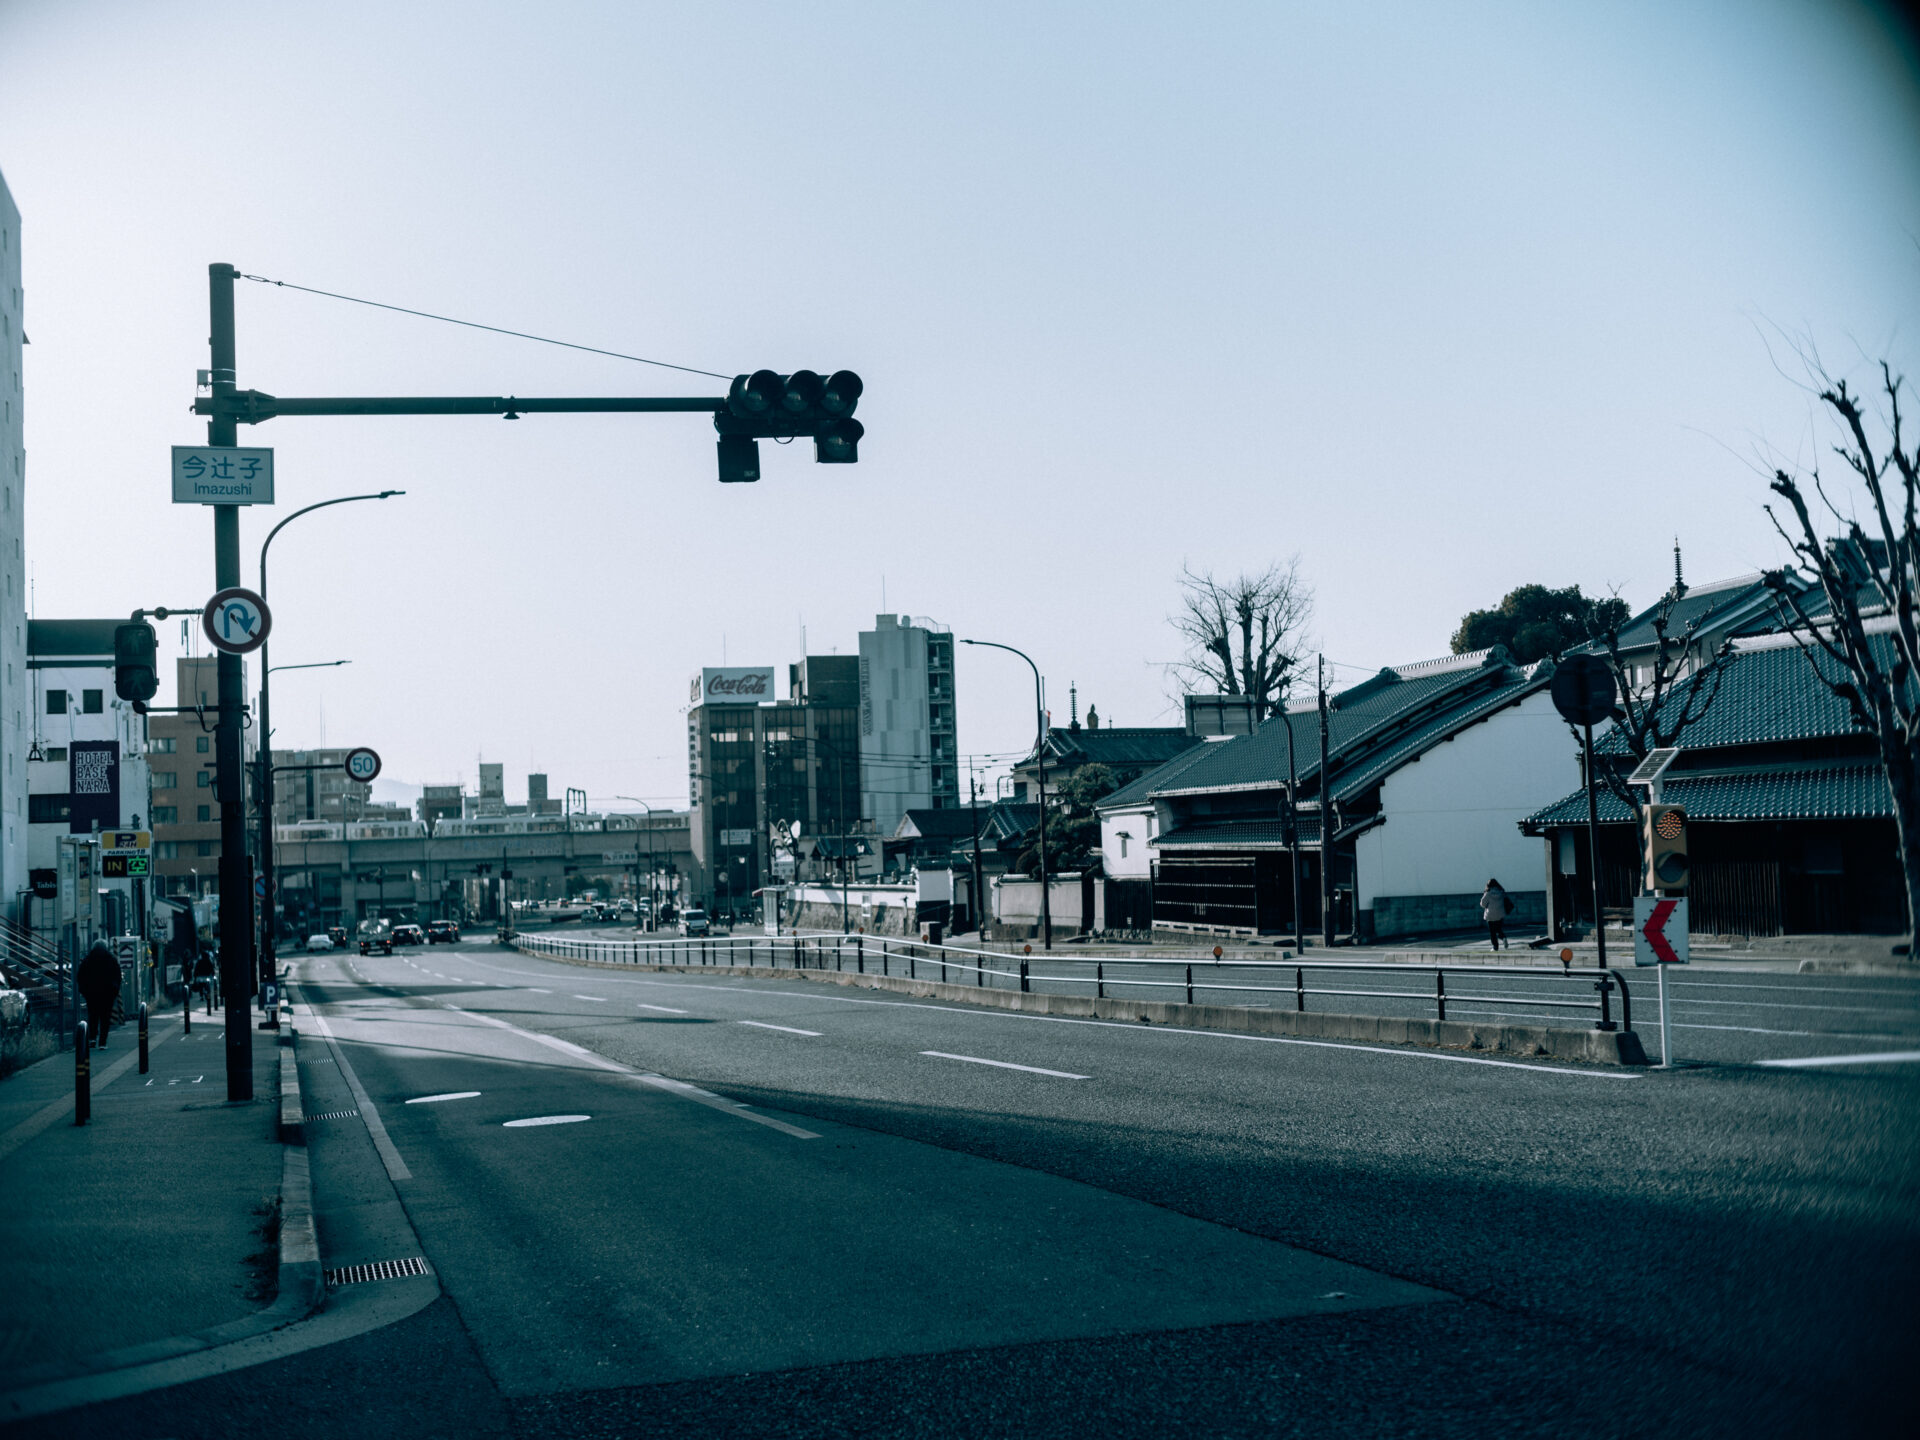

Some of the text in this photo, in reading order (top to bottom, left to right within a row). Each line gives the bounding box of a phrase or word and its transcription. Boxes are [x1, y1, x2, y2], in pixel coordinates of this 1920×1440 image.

[182, 455, 263, 479] 今辻子
[194, 483, 252, 495] Imazushi
[75, 751, 115, 766] HOTEL
[352, 756, 373, 773] 50
[75, 765, 108, 779] BASE
[75, 779, 111, 794] NARA
[115, 833, 137, 848] P
[107, 861, 122, 871] IN
[266, 985, 276, 1003] P
